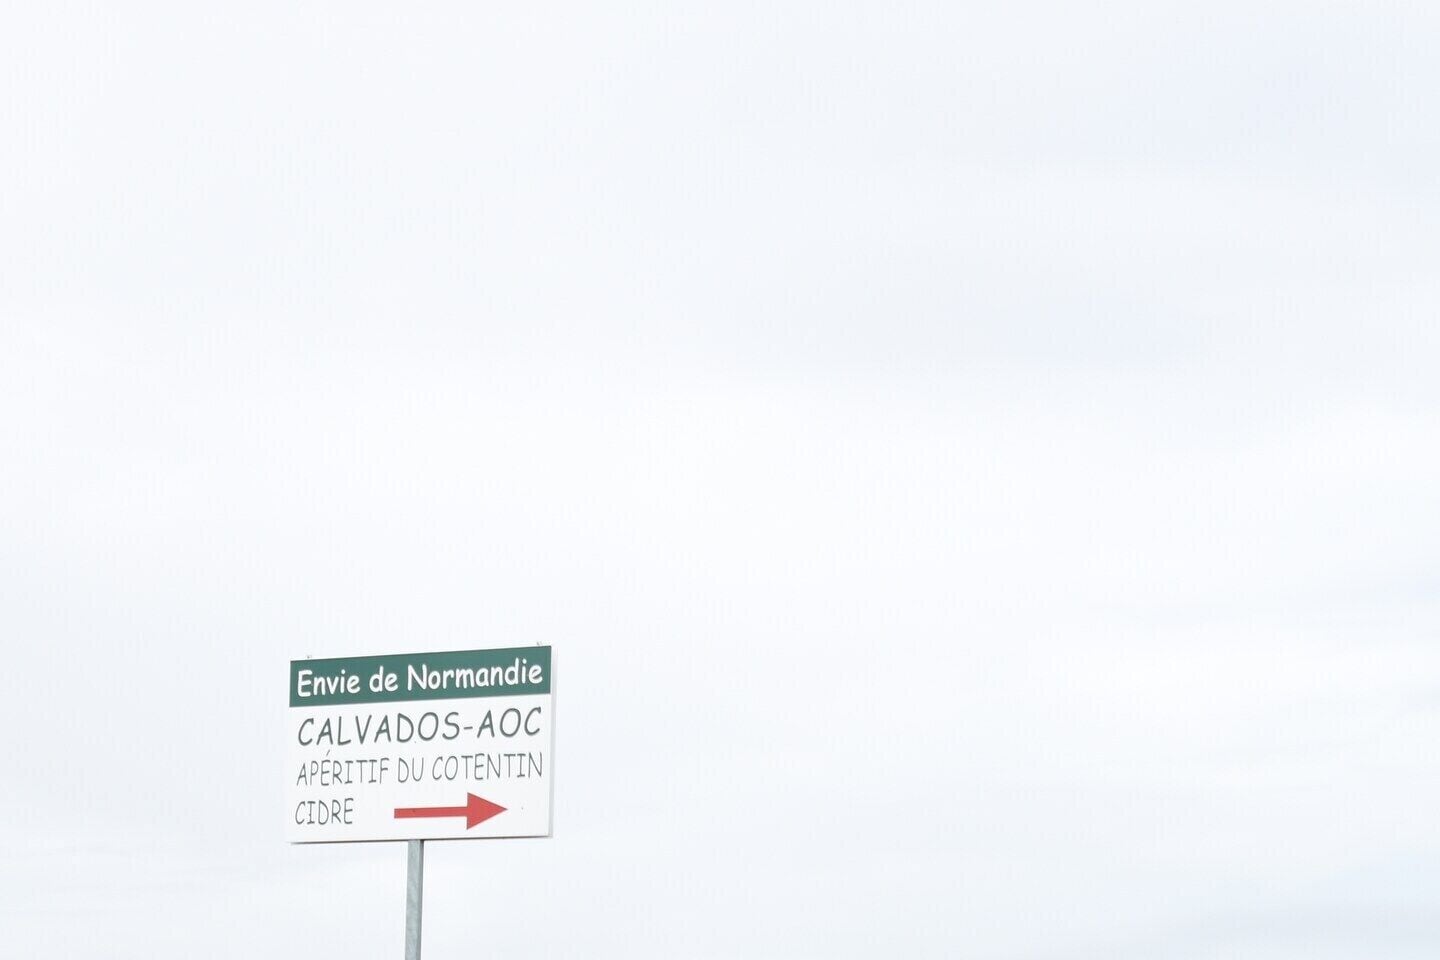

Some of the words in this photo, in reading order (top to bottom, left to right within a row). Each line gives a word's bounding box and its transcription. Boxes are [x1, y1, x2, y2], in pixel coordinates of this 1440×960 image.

[297, 669, 361, 697] Envie
[369, 665, 399, 693] de
[407, 657, 543, 691] Normandie
[297, 706, 542, 746] CALVADOS-AOC
[296, 750, 390, 787] APÉRITIF
[397, 757, 425, 783] DU
[432, 751, 543, 781] COTENTIN
[294, 797, 354, 825] CIDRE
